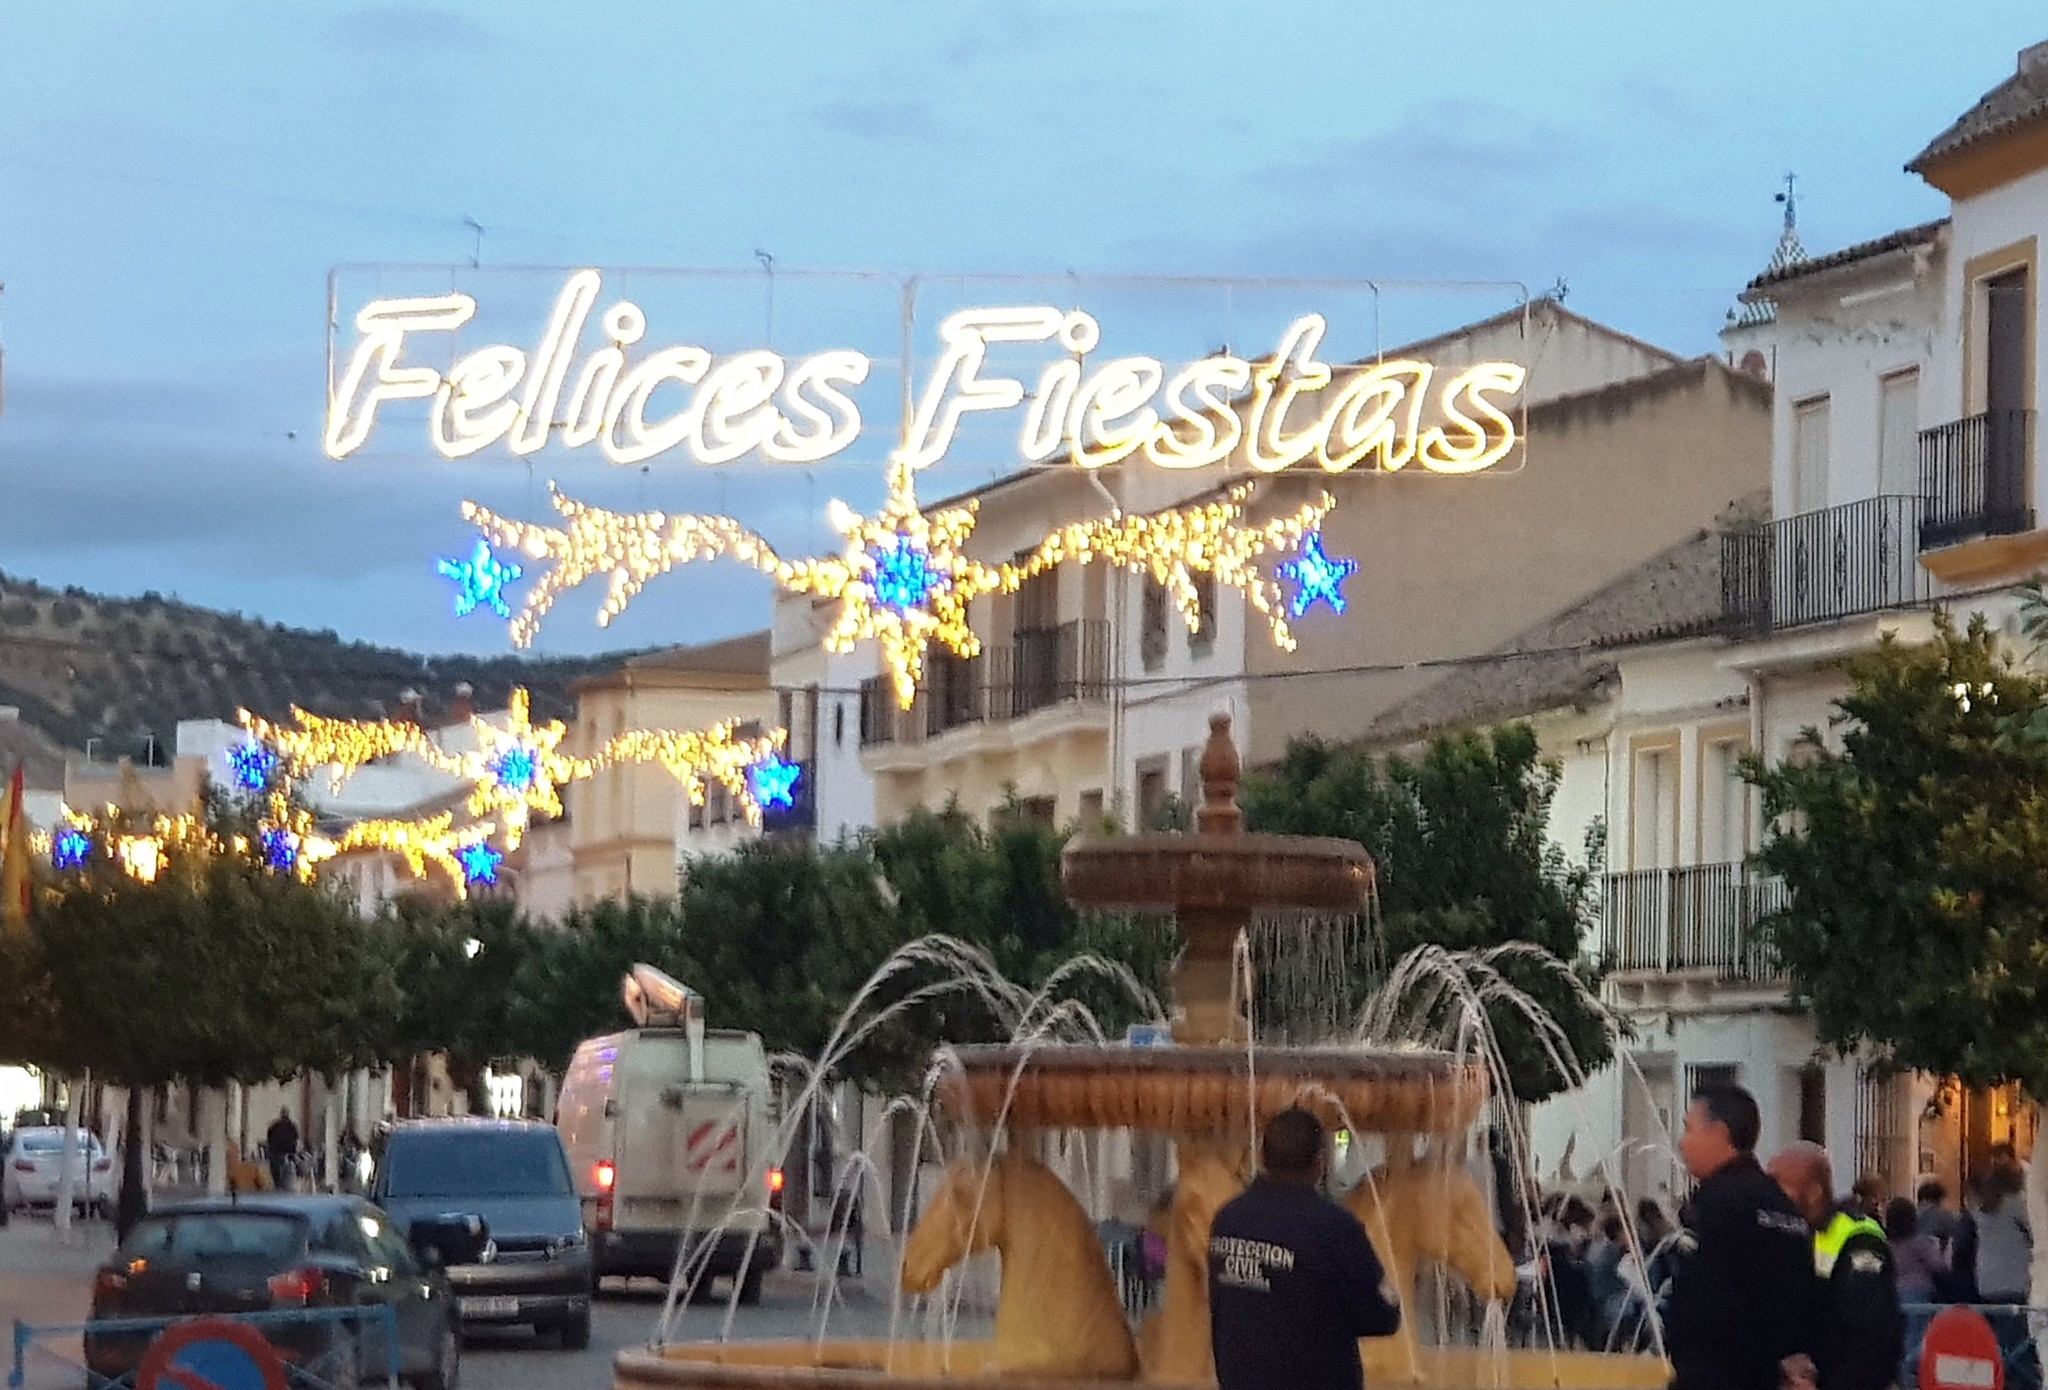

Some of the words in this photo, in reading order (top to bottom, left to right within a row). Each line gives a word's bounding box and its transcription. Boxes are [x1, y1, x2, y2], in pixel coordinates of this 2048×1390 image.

[325, 268, 869, 463] Felices
[907, 306, 1526, 473] Fiestas
[1225, 1255, 1263, 1280] CIVIL
